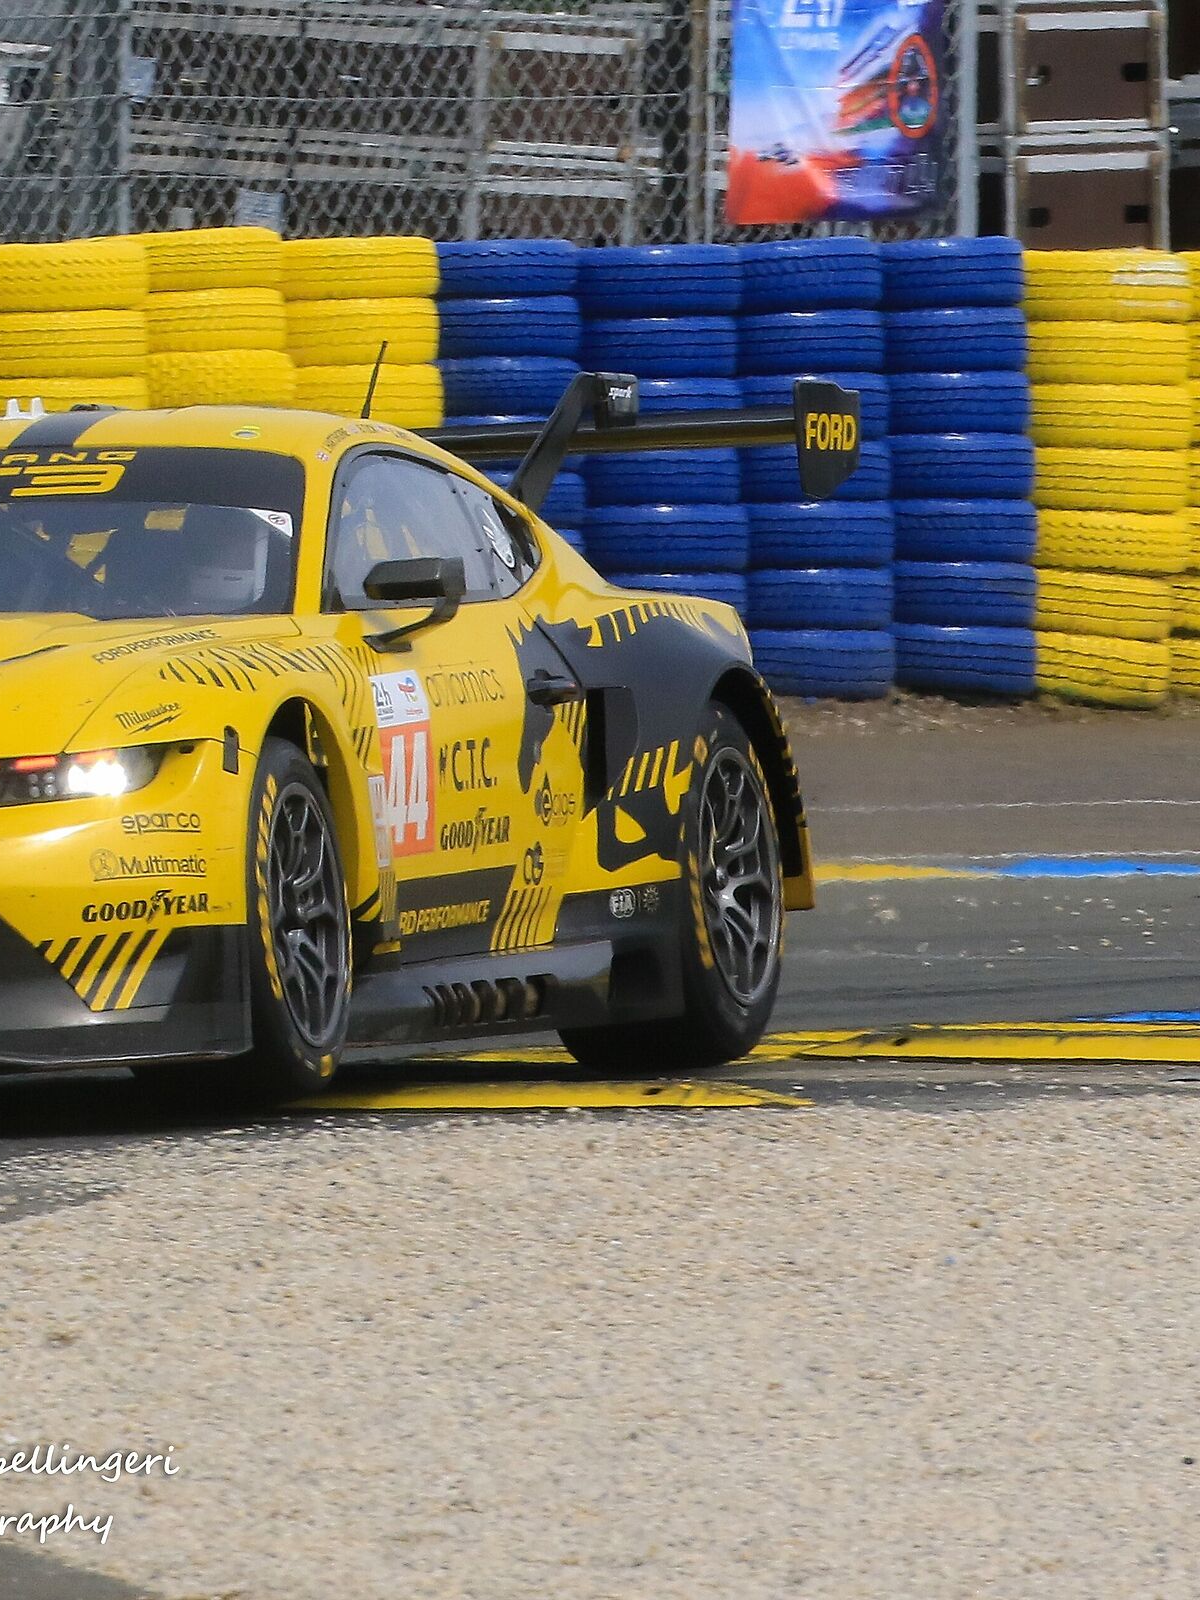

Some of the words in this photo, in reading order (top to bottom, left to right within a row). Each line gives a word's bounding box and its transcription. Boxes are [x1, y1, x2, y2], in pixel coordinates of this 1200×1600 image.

[805, 413, 856, 450] FORD
[115, 702, 181, 729] Milwaukee
[386, 731, 429, 844] 44
[121, 811, 201, 834] sparco
[120, 855, 207, 875] Multimatic
[82, 890, 208, 923] GOODYEAR
